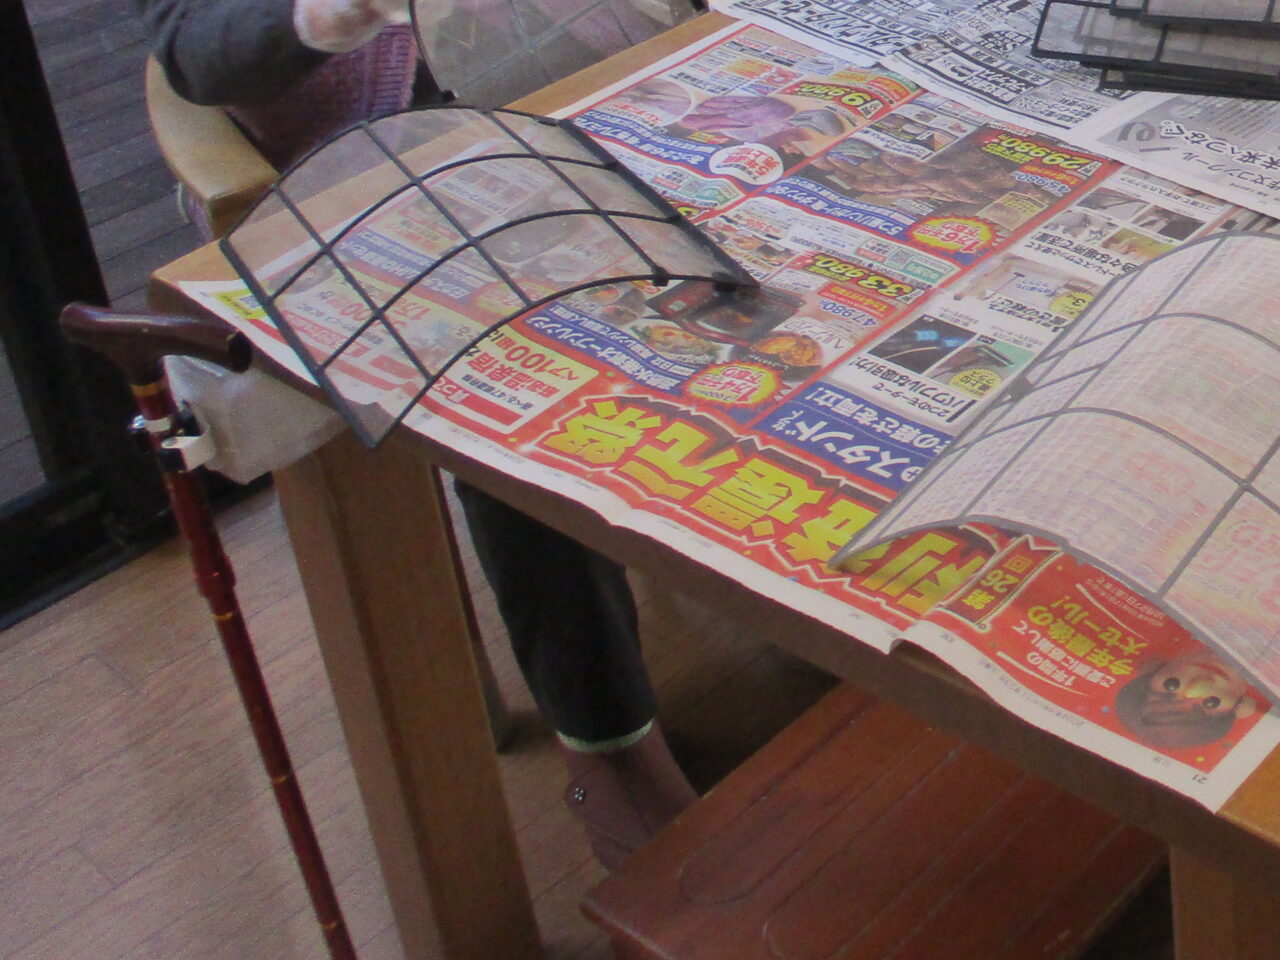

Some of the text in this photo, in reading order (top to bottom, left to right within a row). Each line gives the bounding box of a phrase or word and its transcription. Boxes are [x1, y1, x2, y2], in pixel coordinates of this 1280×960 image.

[1022, 240, 1123, 279] ードレスでサッと使えて
[845, 355, 969, 409] パワフルな吸引力!
[868, 380, 953, 418] 2つのモーターで
[781, 413, 915, 480] スタンド
[1007, 617, 1118, 689] ご愛顧に感謝して
[1019, 601, 1141, 678] 今年最後の
[1046, 592, 1149, 659] 大セール!
[1020, 649, 1079, 687] 1年間の
